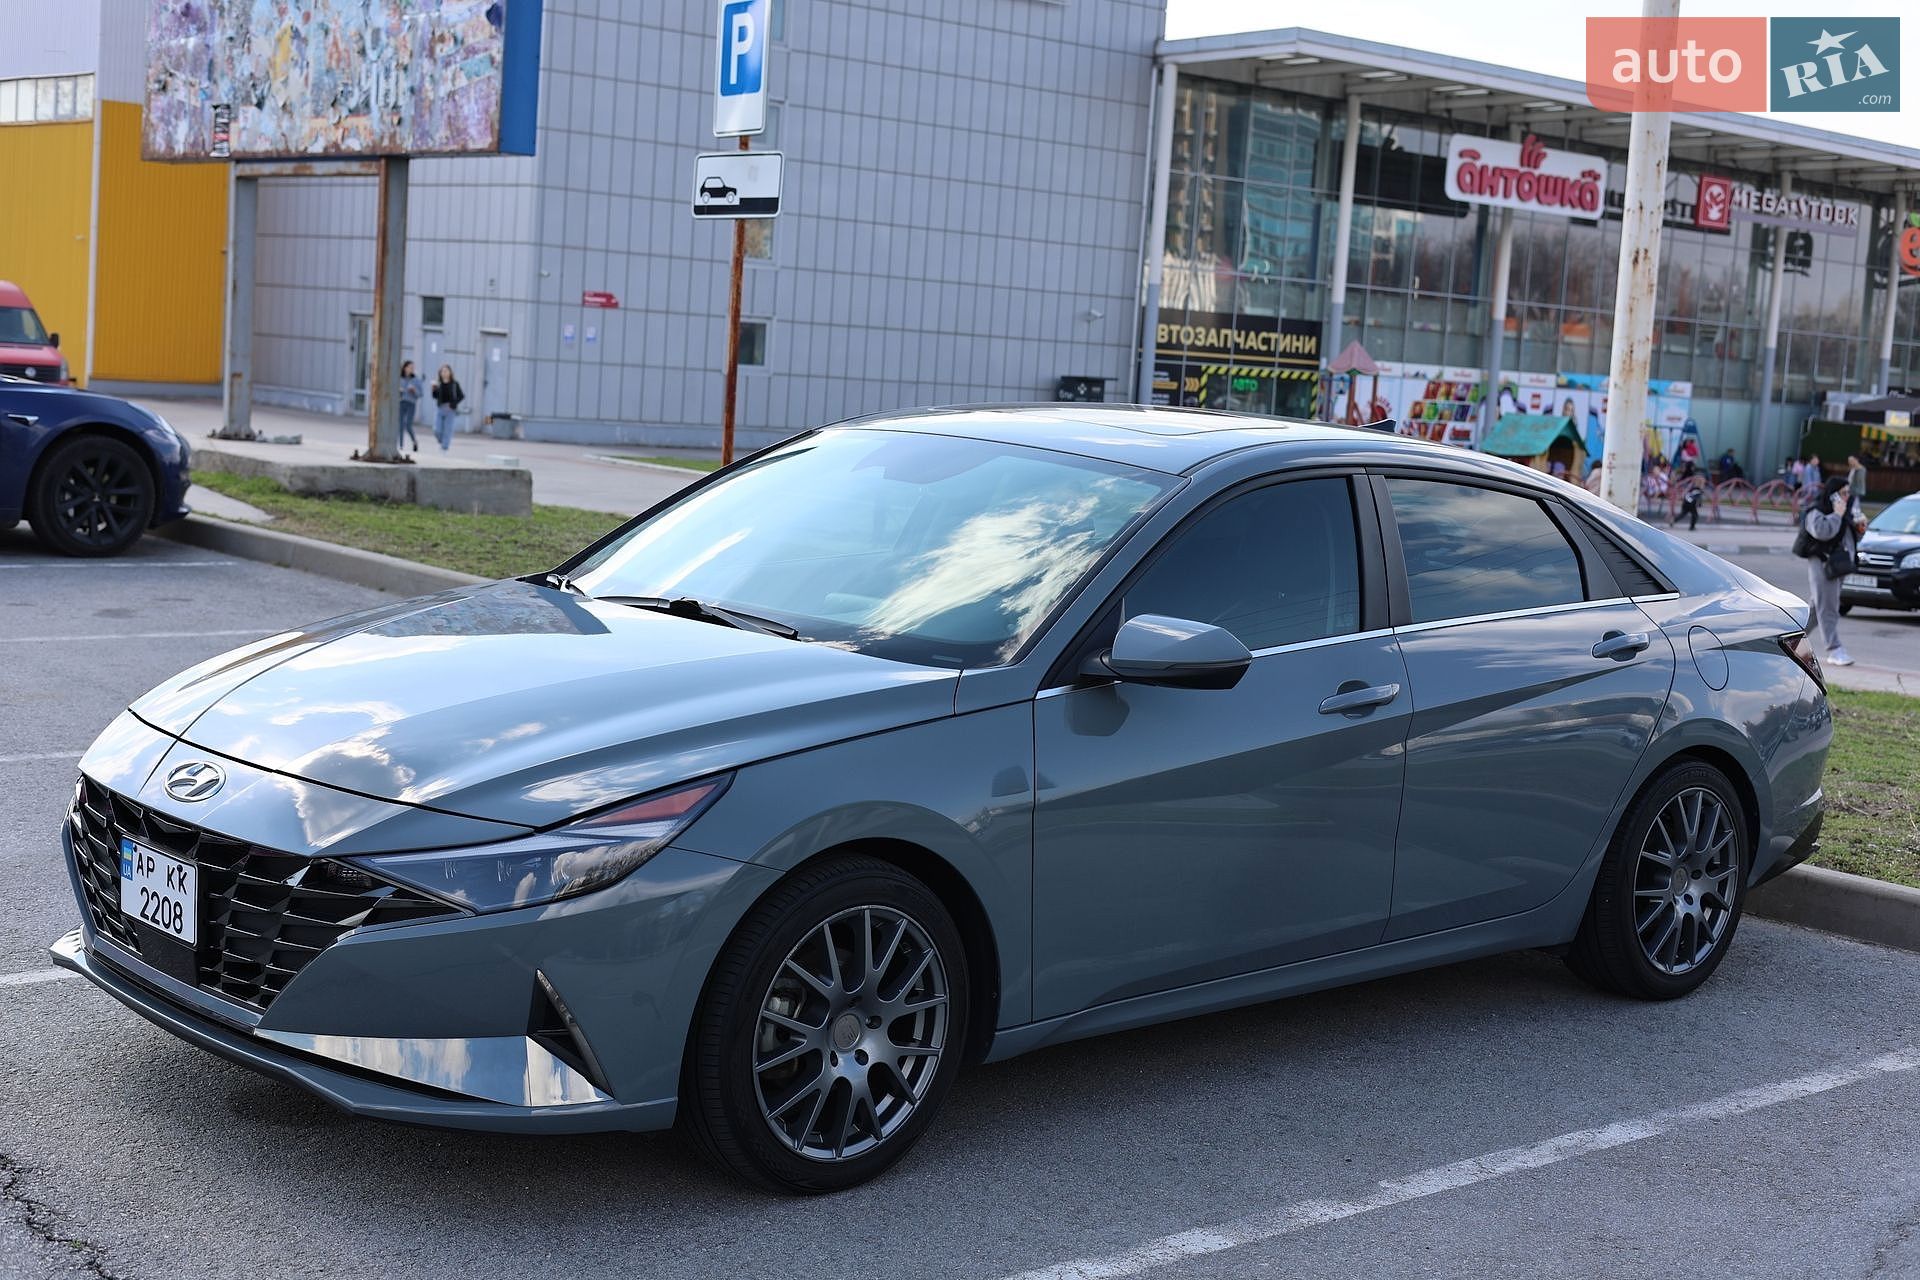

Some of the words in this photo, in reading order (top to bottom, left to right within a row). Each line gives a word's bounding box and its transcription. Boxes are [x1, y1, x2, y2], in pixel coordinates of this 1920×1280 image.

[729, 12, 755, 85] P
[1156, 323, 1317, 355] ВТОЗАПЧАСТИНИ
[136, 852, 155, 879] AP
[166, 864, 188, 896] KK
[140, 886, 184, 935] 2208
